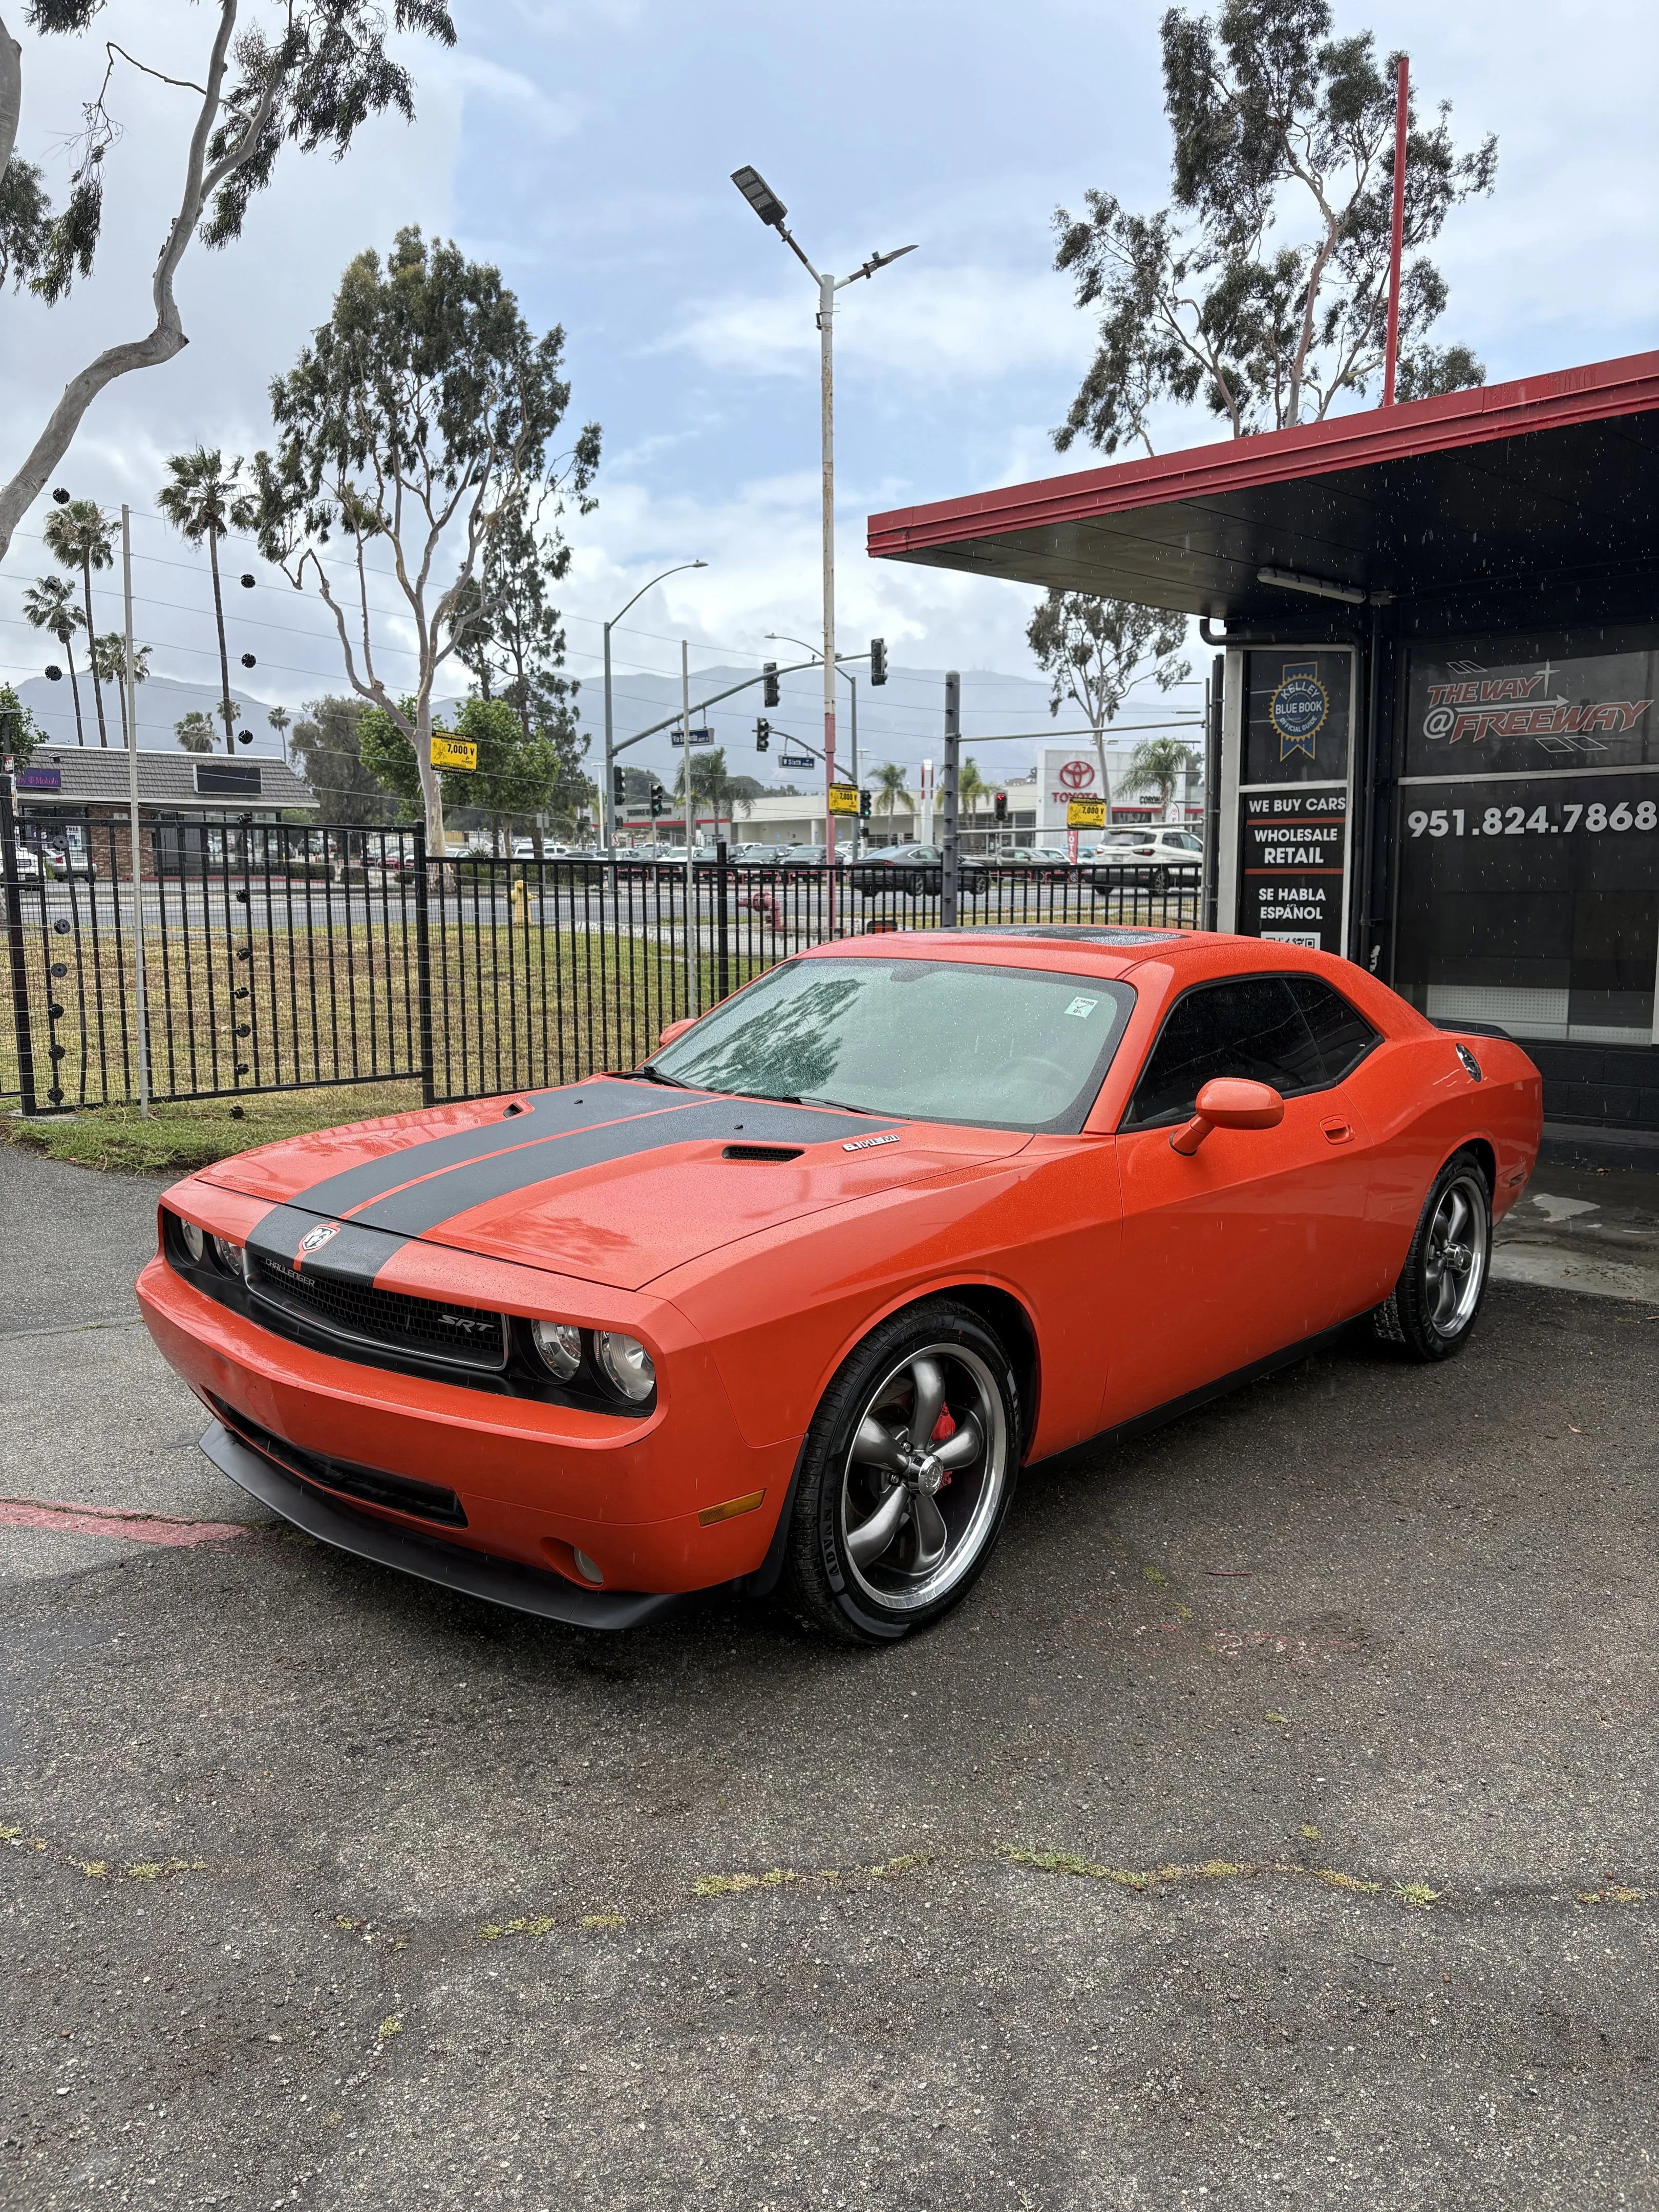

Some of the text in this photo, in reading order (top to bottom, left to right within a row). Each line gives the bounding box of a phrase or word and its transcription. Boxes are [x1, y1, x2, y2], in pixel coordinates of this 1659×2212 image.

[1281, 682, 1320, 700] KELLEY
[1427, 675, 1544, 709] THE WAY
[1275, 700, 1323, 715] BLUE BOOK
[1280, 715, 1318, 732] OFFICIAL GUIDE
[447, 743, 475, 756] 7,000 V
[35, 777, 58, 785] Mobile
[1082, 806, 1099, 815] 7,000
[1248, 797, 1346, 813] WE BUY CARS
[1408, 801, 1657, 838] 951.824.7868
[1254, 828, 1337, 842] WHOLESALE
[1264, 847, 1324, 864] RETAIL
[1259, 888, 1326, 901] SE HABLA
[1260, 904, 1323, 920] ESPAÑOL
[265, 1258, 315, 1287] CHALLENGER
[438, 1314, 495, 1333] SRT
